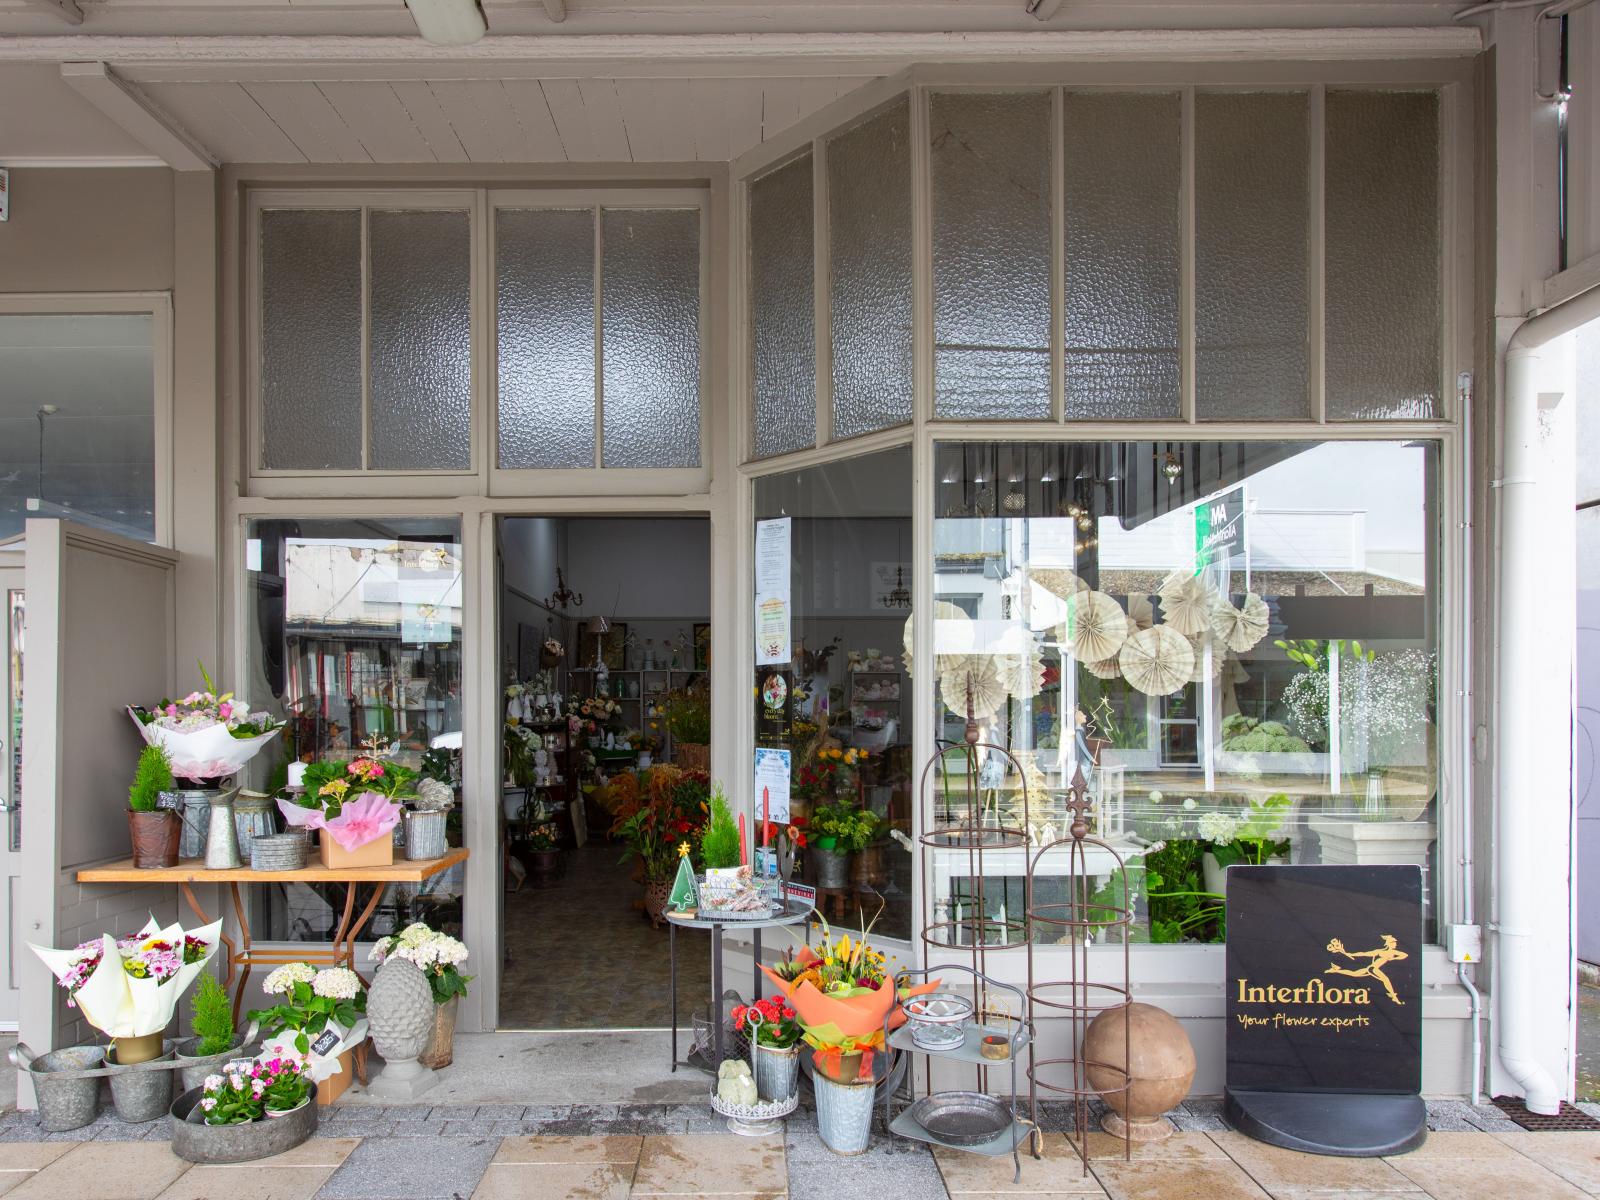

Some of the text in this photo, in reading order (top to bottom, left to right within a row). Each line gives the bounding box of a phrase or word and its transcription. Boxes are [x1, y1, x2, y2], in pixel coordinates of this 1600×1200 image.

[1237, 978, 1370, 1004] Interflora
[1237, 1012, 1370, 1032] Your flower experts
